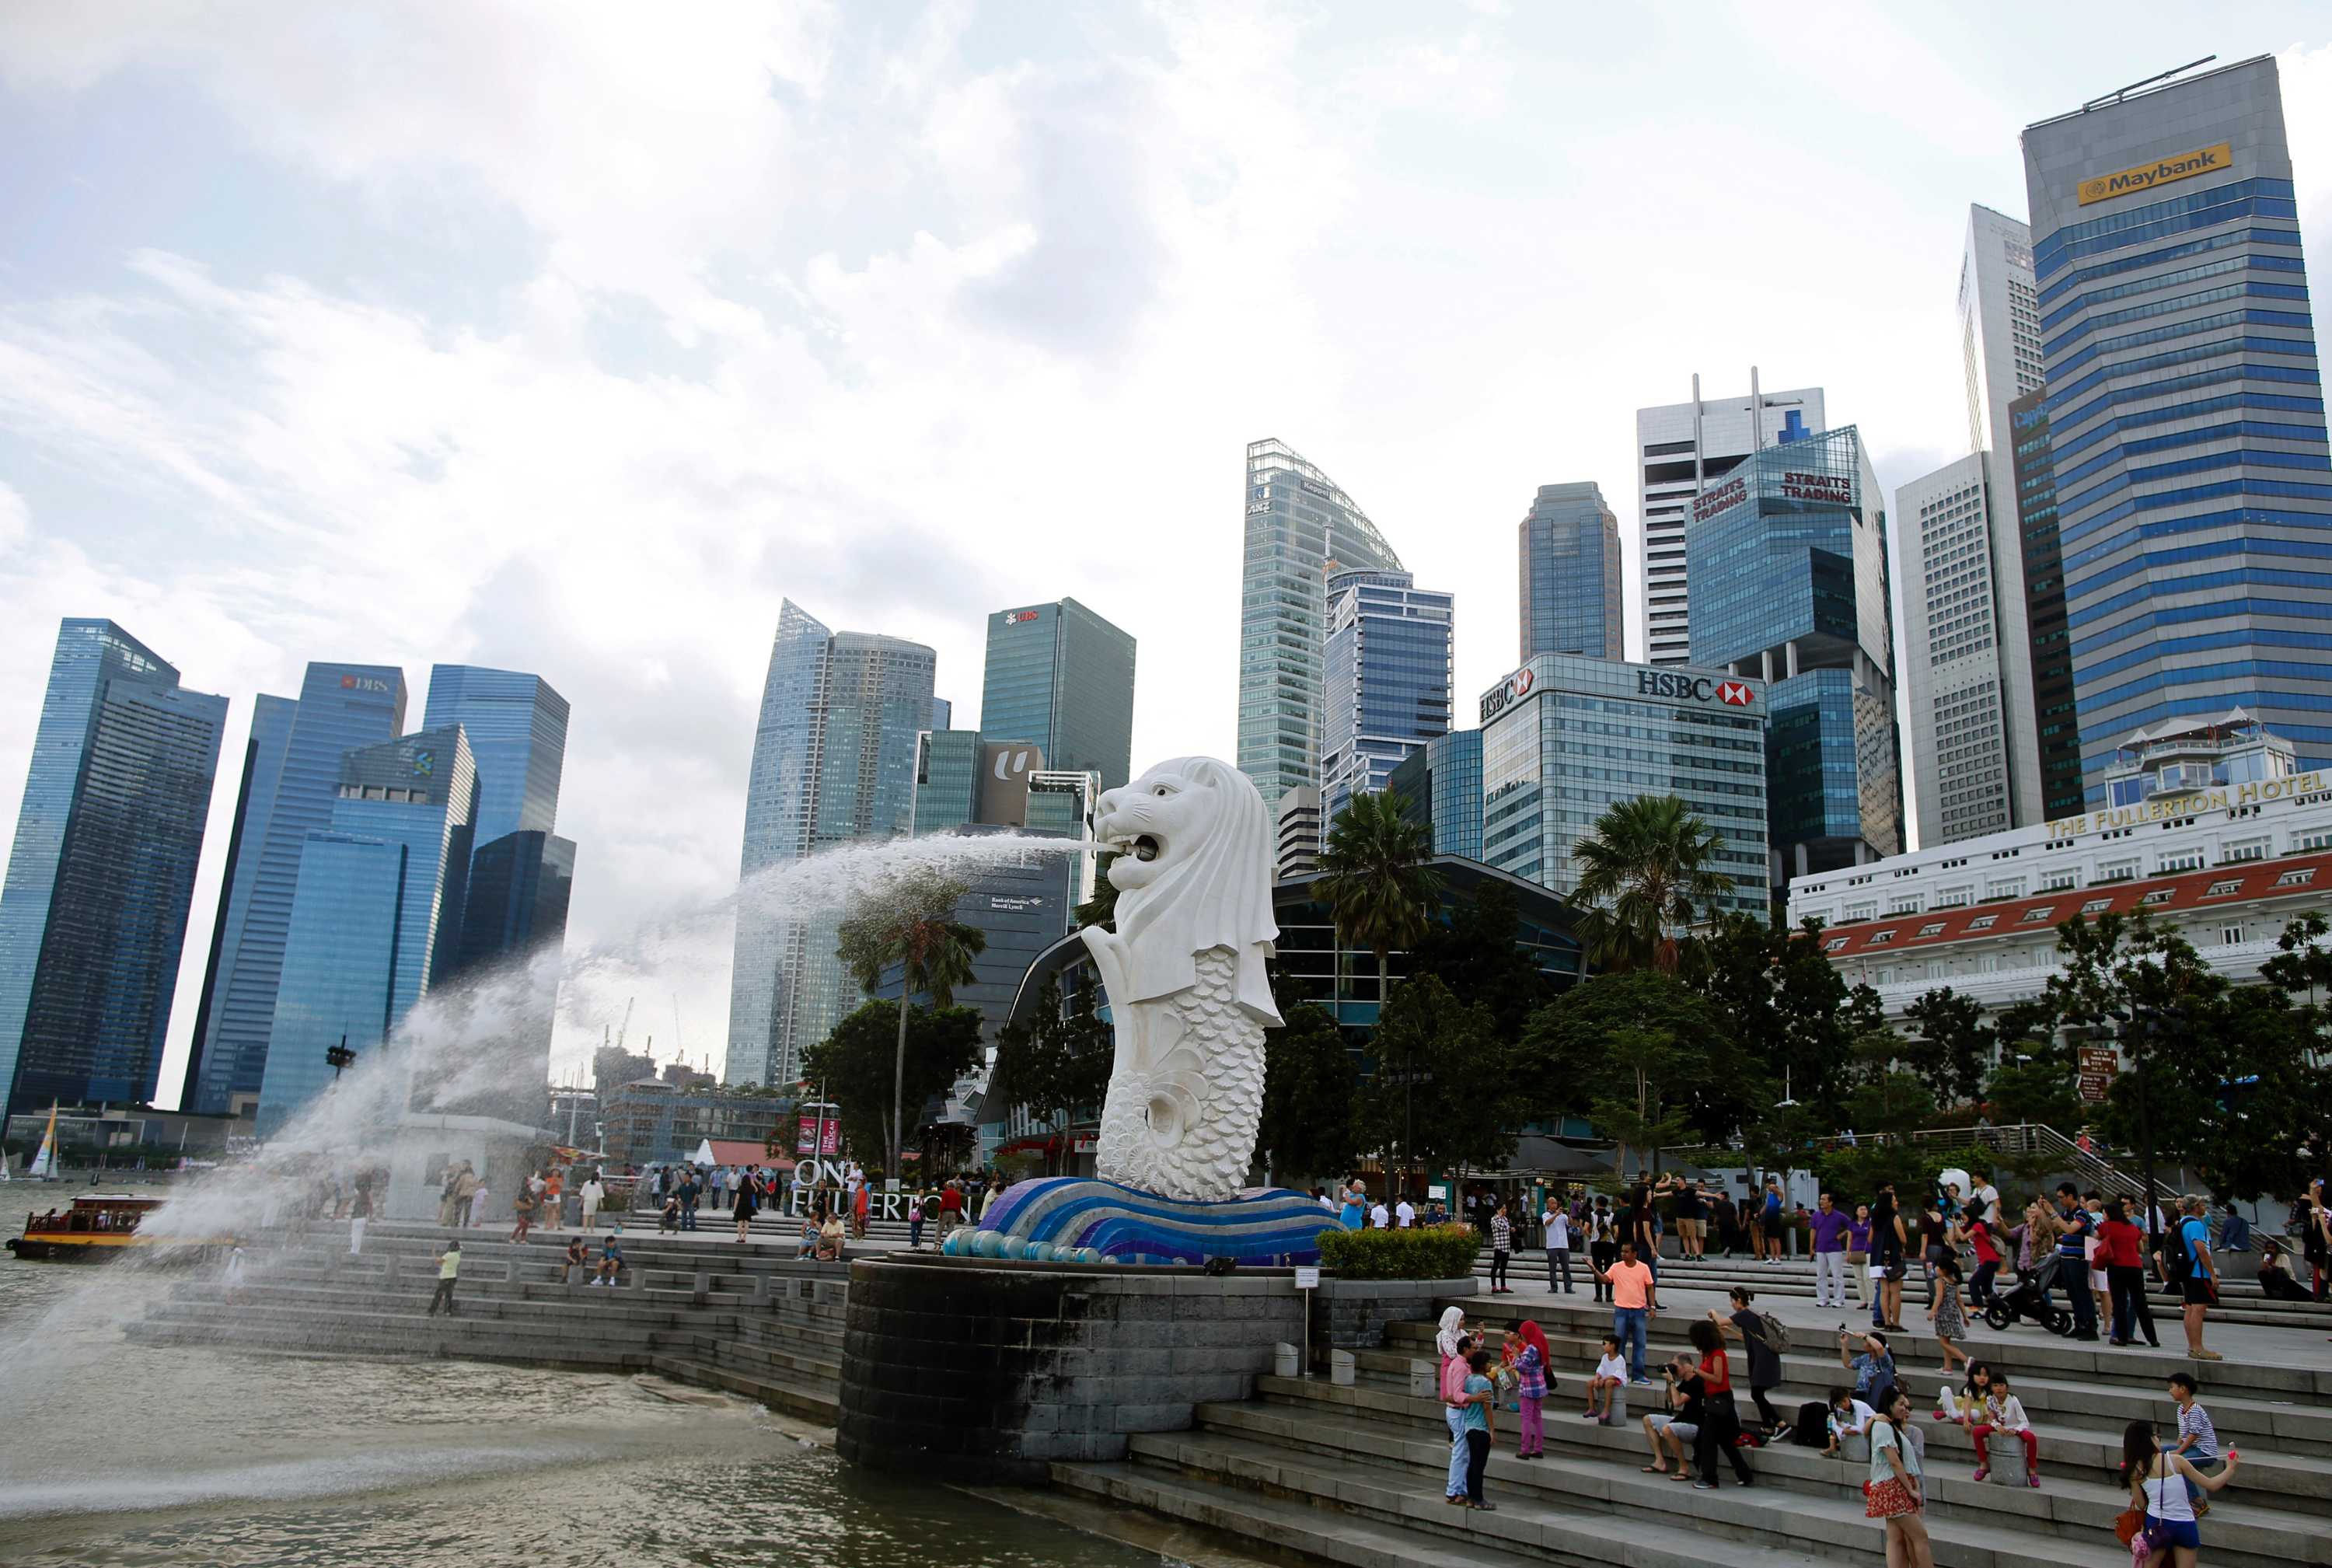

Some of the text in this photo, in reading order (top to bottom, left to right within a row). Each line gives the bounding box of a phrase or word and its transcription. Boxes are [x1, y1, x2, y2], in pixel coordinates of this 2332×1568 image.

[2109, 152, 2216, 192] Maybank
[1692, 477, 1744, 511] STRAITS
[1781, 485, 1852, 504] TRADING
[1785, 472, 1851, 489] STRAITS
[1248, 501, 1271, 515] ANZ
[1693, 490, 1748, 523] TRADING
[1480, 679, 1515, 723] HSBC
[1637, 670, 1712, 702] HSBC
[2046, 772, 2327, 839] THE FULLERTON HOTEL
[795, 1160, 857, 1189] ON
[791, 1189, 972, 1224] FLERTON
